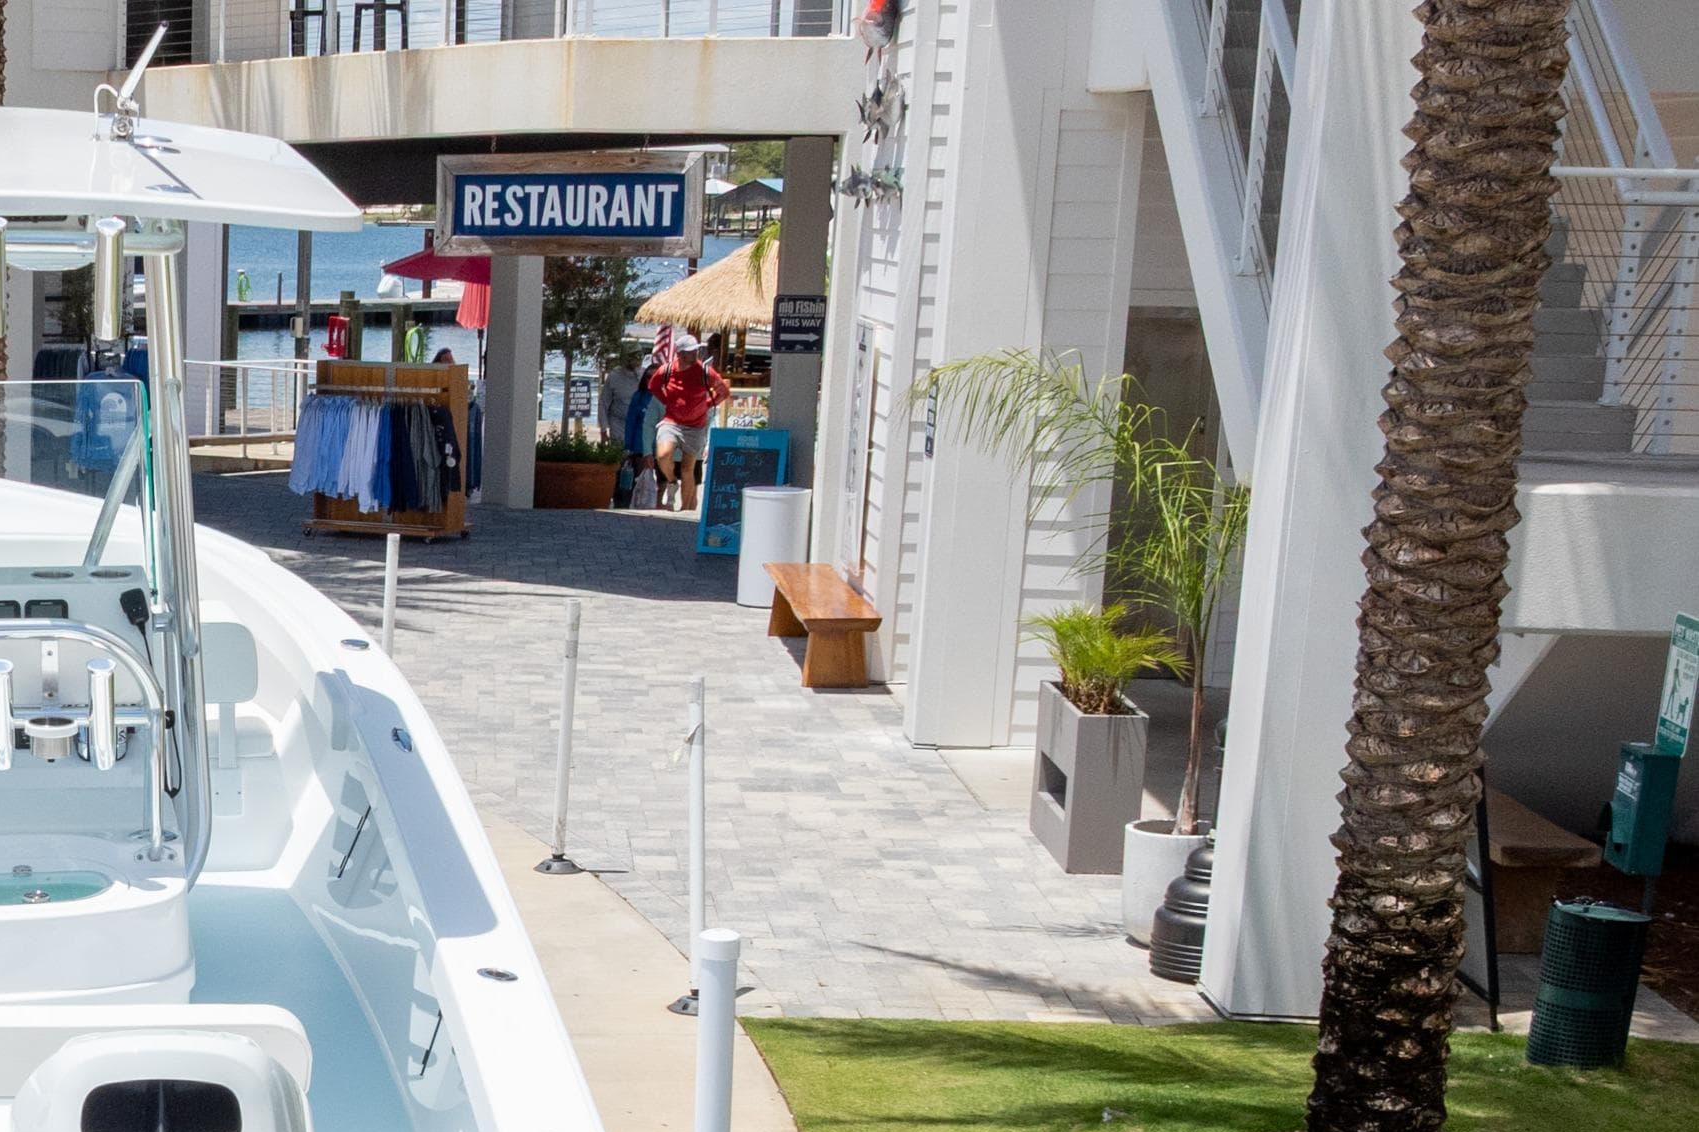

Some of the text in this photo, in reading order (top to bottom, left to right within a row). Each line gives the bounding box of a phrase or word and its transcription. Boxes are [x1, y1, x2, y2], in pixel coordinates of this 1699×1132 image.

[463, 184, 679, 227] RESTAURANT
[781, 318, 821, 327] THIS WAY
